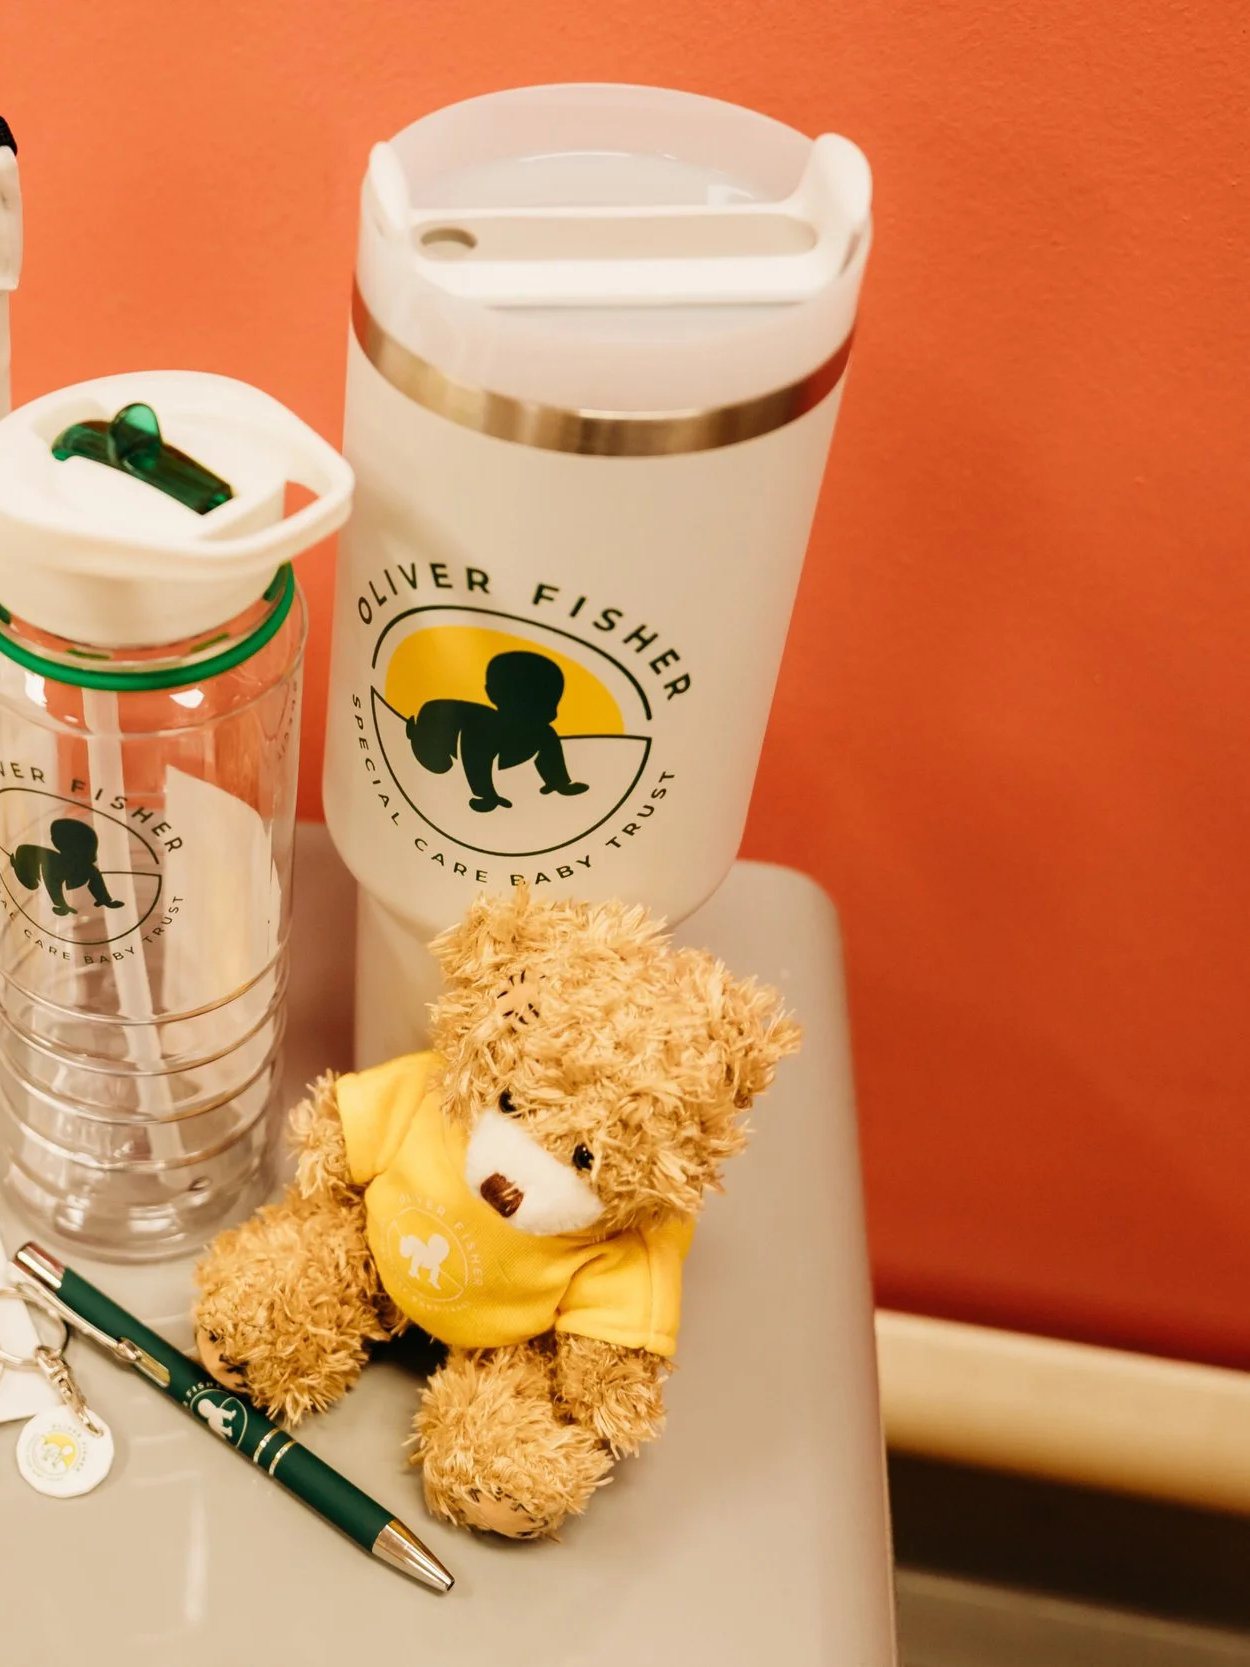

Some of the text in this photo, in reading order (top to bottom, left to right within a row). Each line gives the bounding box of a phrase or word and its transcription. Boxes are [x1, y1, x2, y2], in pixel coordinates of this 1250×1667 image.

[358, 562, 692, 701] OLIVER FISHER
[70, 778, 184, 853] FISHER
[352, 693, 400, 826] SPECIAL
[414, 838, 488, 884] CARE
[510, 855, 593, 888] BABY
[605, 771, 676, 850] TRUST
[23, 929, 71, 961] CARE
[84, 946, 136, 965] BABY
[142, 895, 185, 944] TRUST
